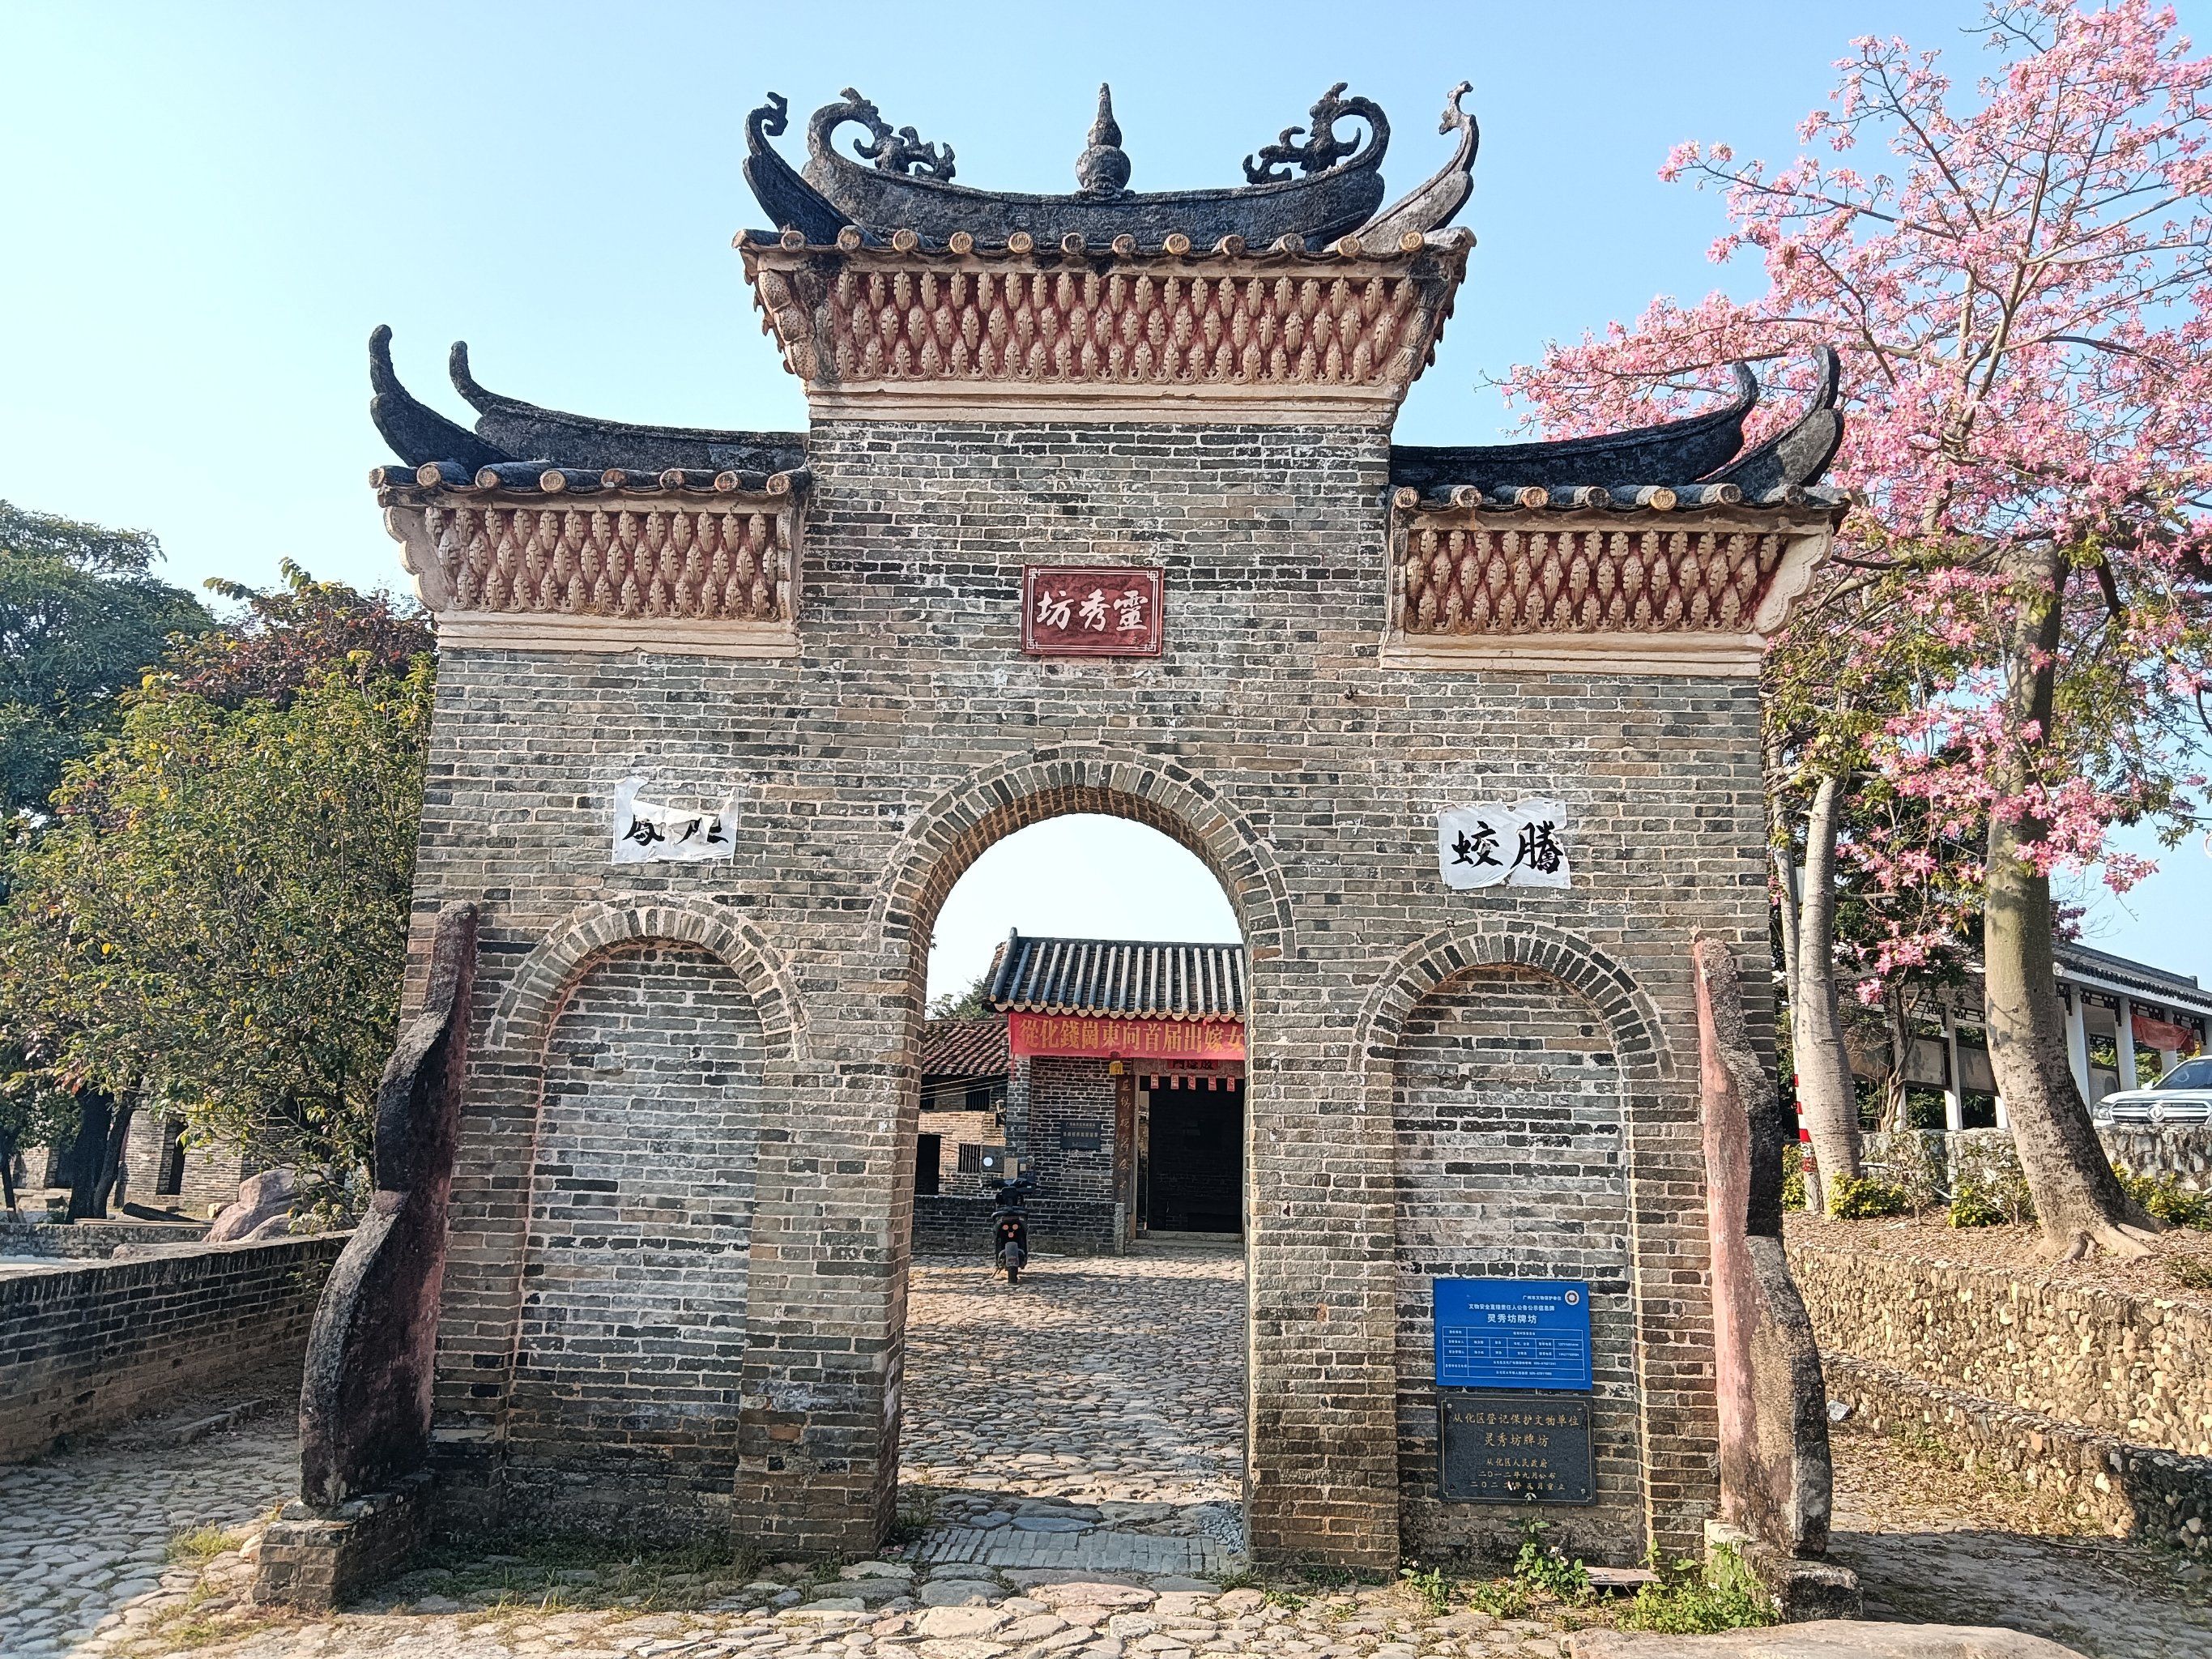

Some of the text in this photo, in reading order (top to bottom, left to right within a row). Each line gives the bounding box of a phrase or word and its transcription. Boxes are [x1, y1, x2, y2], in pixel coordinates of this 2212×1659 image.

[1036, 588, 1149, 632] 靈秀坊
[1487, 1313, 1537, 1325] 灵秀坊牌坊
[1452, 1412, 1579, 1427] 从化区登记保护文物单位
[1484, 1432, 1549, 1448] 灵秀坊牌坊
[1486, 1457, 1549, 1469] 从化区人民政府
